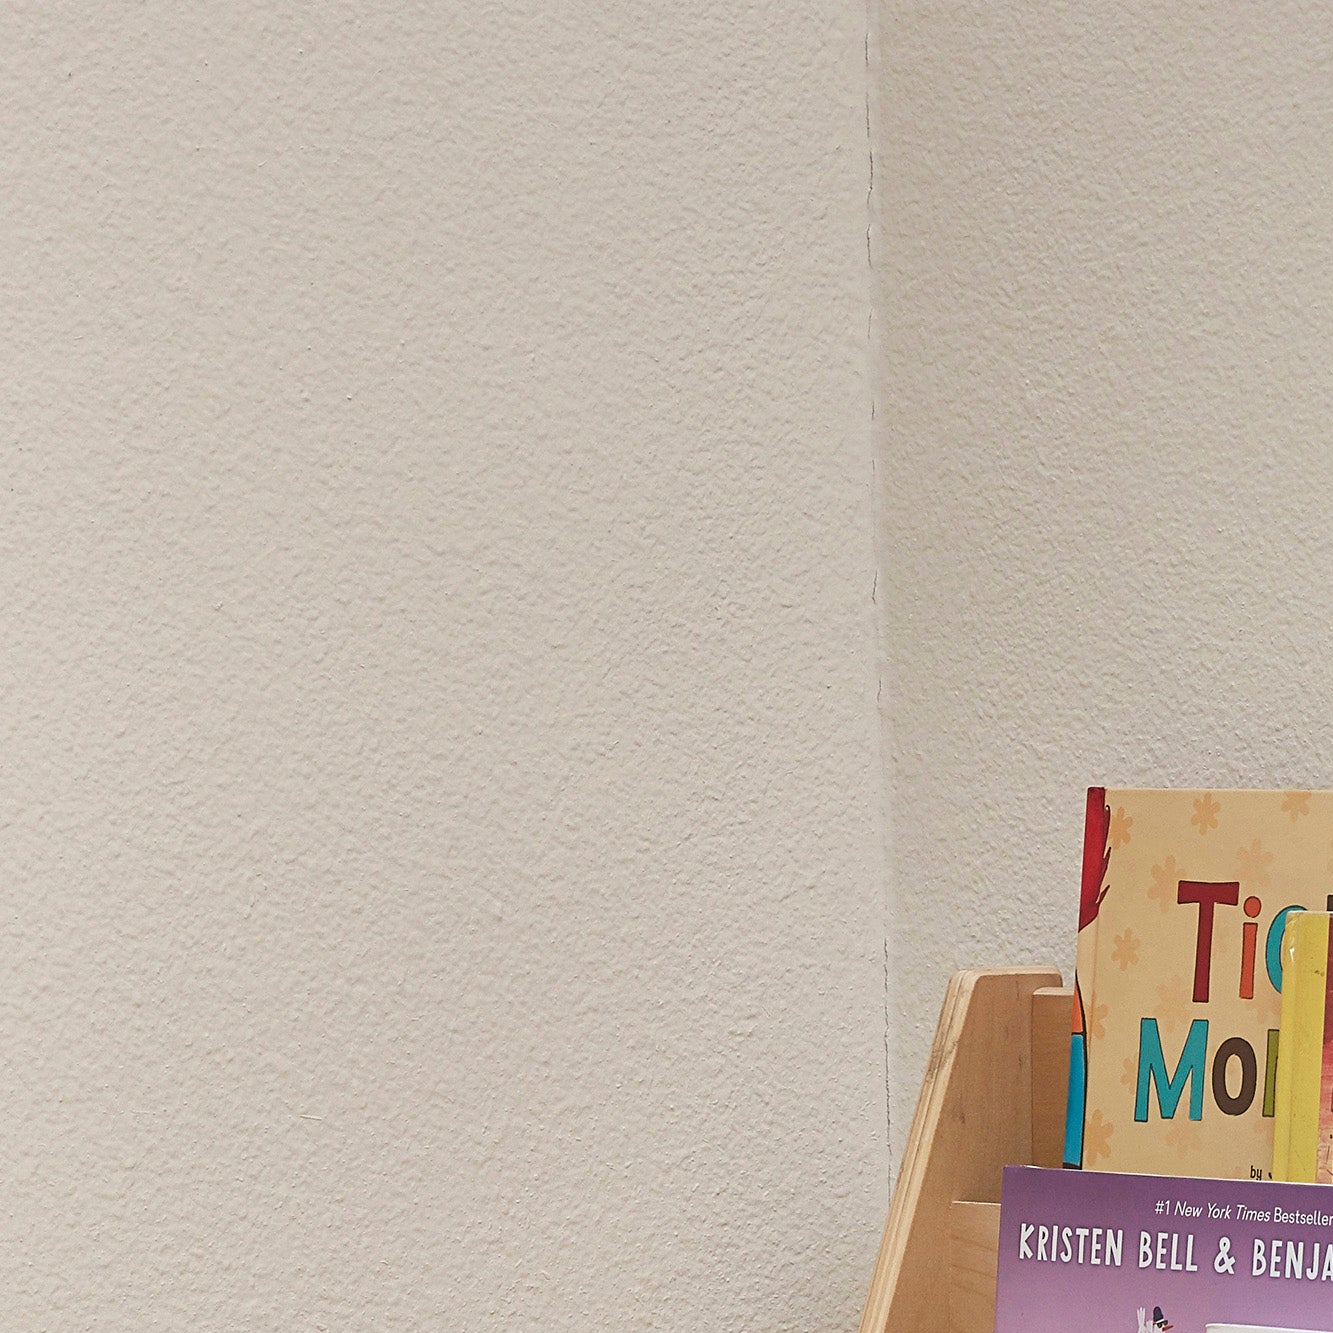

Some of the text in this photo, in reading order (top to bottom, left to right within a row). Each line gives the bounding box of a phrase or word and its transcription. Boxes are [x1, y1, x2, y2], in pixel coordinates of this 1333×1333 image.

[1154, 1200, 1171, 1216] #1
[1173, 1201, 1202, 1218] New
[1206, 1202, 1232, 1220] York
[1235, 1203, 1271, 1223] Times
[1018, 1222, 1124, 1267] KRISTEN
[1138, 1231, 1199, 1273] BELL
[1213, 1236, 1236, 1276] &
